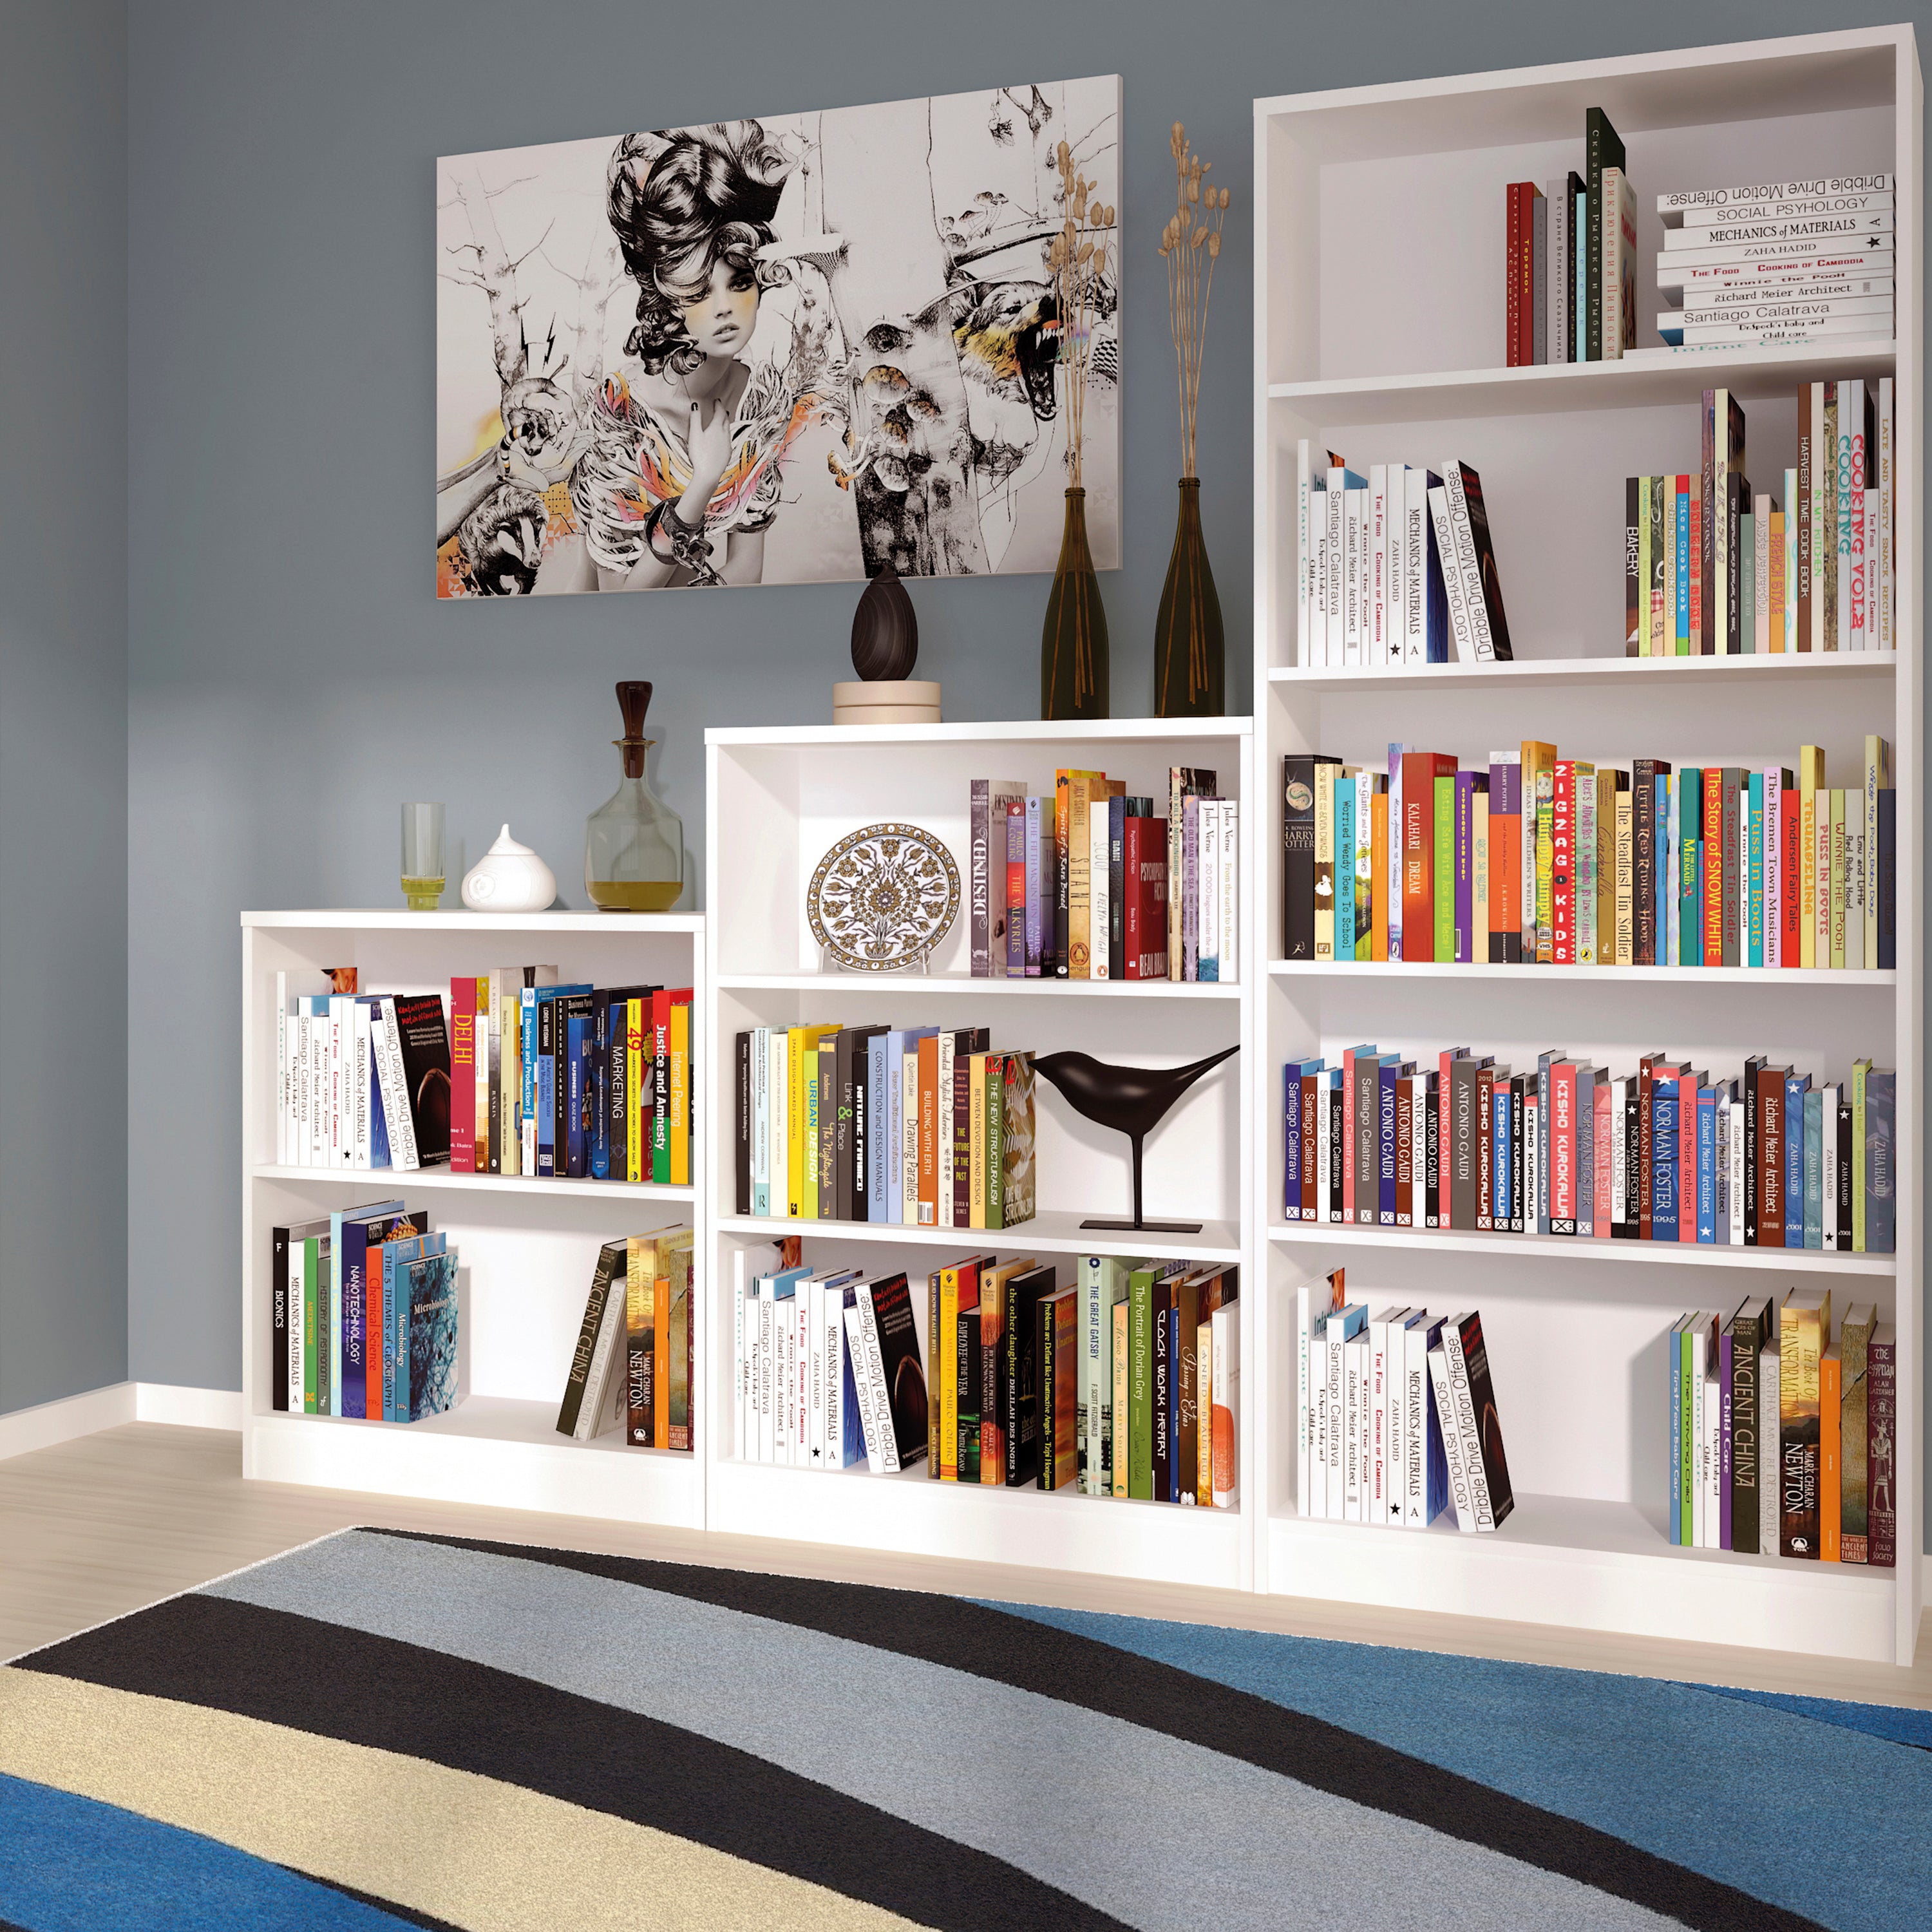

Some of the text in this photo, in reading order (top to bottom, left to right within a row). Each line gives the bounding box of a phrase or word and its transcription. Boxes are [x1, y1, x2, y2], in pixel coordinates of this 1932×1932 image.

[1717, 197, 1868, 221] SOCIAL PSYHOLOGY
[1732, 185, 1783, 200] Motion
[1788, 180, 1825, 194] Drive
[1831, 175, 1885, 189] Dribble
[1710, 220, 1855, 242] MECHANICS of MATERIALS
[1779, 243, 1816, 252] HADID
[1684, 304, 1829, 323] Santiago Calatrava
[1762, 290, 1793, 299] Meier
[1798, 285, 1852, 295] Architect
[1838, 435, 1851, 556] COOKING
[1851, 435, 1864, 556] COOKING
[1329, 491, 1341, 615] Santiago Calatrava
[1627, 527, 1639, 577] BAKERY
[1772, 533, 1783, 614] FRENCH STYLE
[1202, 806, 1213, 853] Jules Verne
[1343, 800, 1351, 837] Worried
[1343, 843, 1351, 870] Wendy
[1408, 803, 1420, 895] KALAHARI DREAM
[1705, 772, 1721, 956] The Story of SNOW WHITE
[1752, 810, 1763, 945] Puss in Boots
[1768, 773, 1777, 963] The Bremen Town Musicians
[1787, 816, 1797, 932] Andersen Fairy Tales
[1343, 902, 1350, 912] To
[1618, 805, 1632, 959] The Steadfast Tin Soldier
[1012, 876, 1021, 952] THE VALKYRIES
[1343, 918, 1351, 949] School
[455, 1014, 472, 1065] DELHI
[612, 1046, 623, 1119] MARKETING
[655, 1025, 666, 1150] Justice and Amnesty
[809, 1080, 817, 1182] URBAN DESIGN
[838, 1107, 853, 1120] &
[1286, 1082, 1299, 1180] Santiago Calatrava
[1382, 1085, 1394, 1179] ANTONIO GAUDI
[1399, 1097, 1410, 1184] ANTONIO GAUDI
[1656, 1100, 1671, 1160] NORMAN
[1766, 1097, 1779, 1133] Richard
[1557, 1080, 1568, 1218] KISHO KUROKAWA
[1766, 1137, 1779, 1165] Meier
[1875, 1142, 1886, 1197] ZAHA HADID
[1656, 1162, 1671, 1210] FOSTER
[1766, 1168, 1779, 1213] Architect
[275, 1290, 283, 1328] BIONICS
[350, 1265, 359, 1365] NANOTECHNOLOGY
[413, 1298, 450, 1314] Microbiology
[1090, 1285, 1099, 1359] THE GREAT GATSBY
[396, 1314, 407, 1367] Microbiology
[1133, 1286, 1144, 1400] The Portrait of Dorian Grey
[1734, 1344, 1754, 1487] ANCIENT CHINA
[1786, 1443, 1803, 1514] NEWTON
[1804, 1451, 1814, 1509] MARK CHARAN
